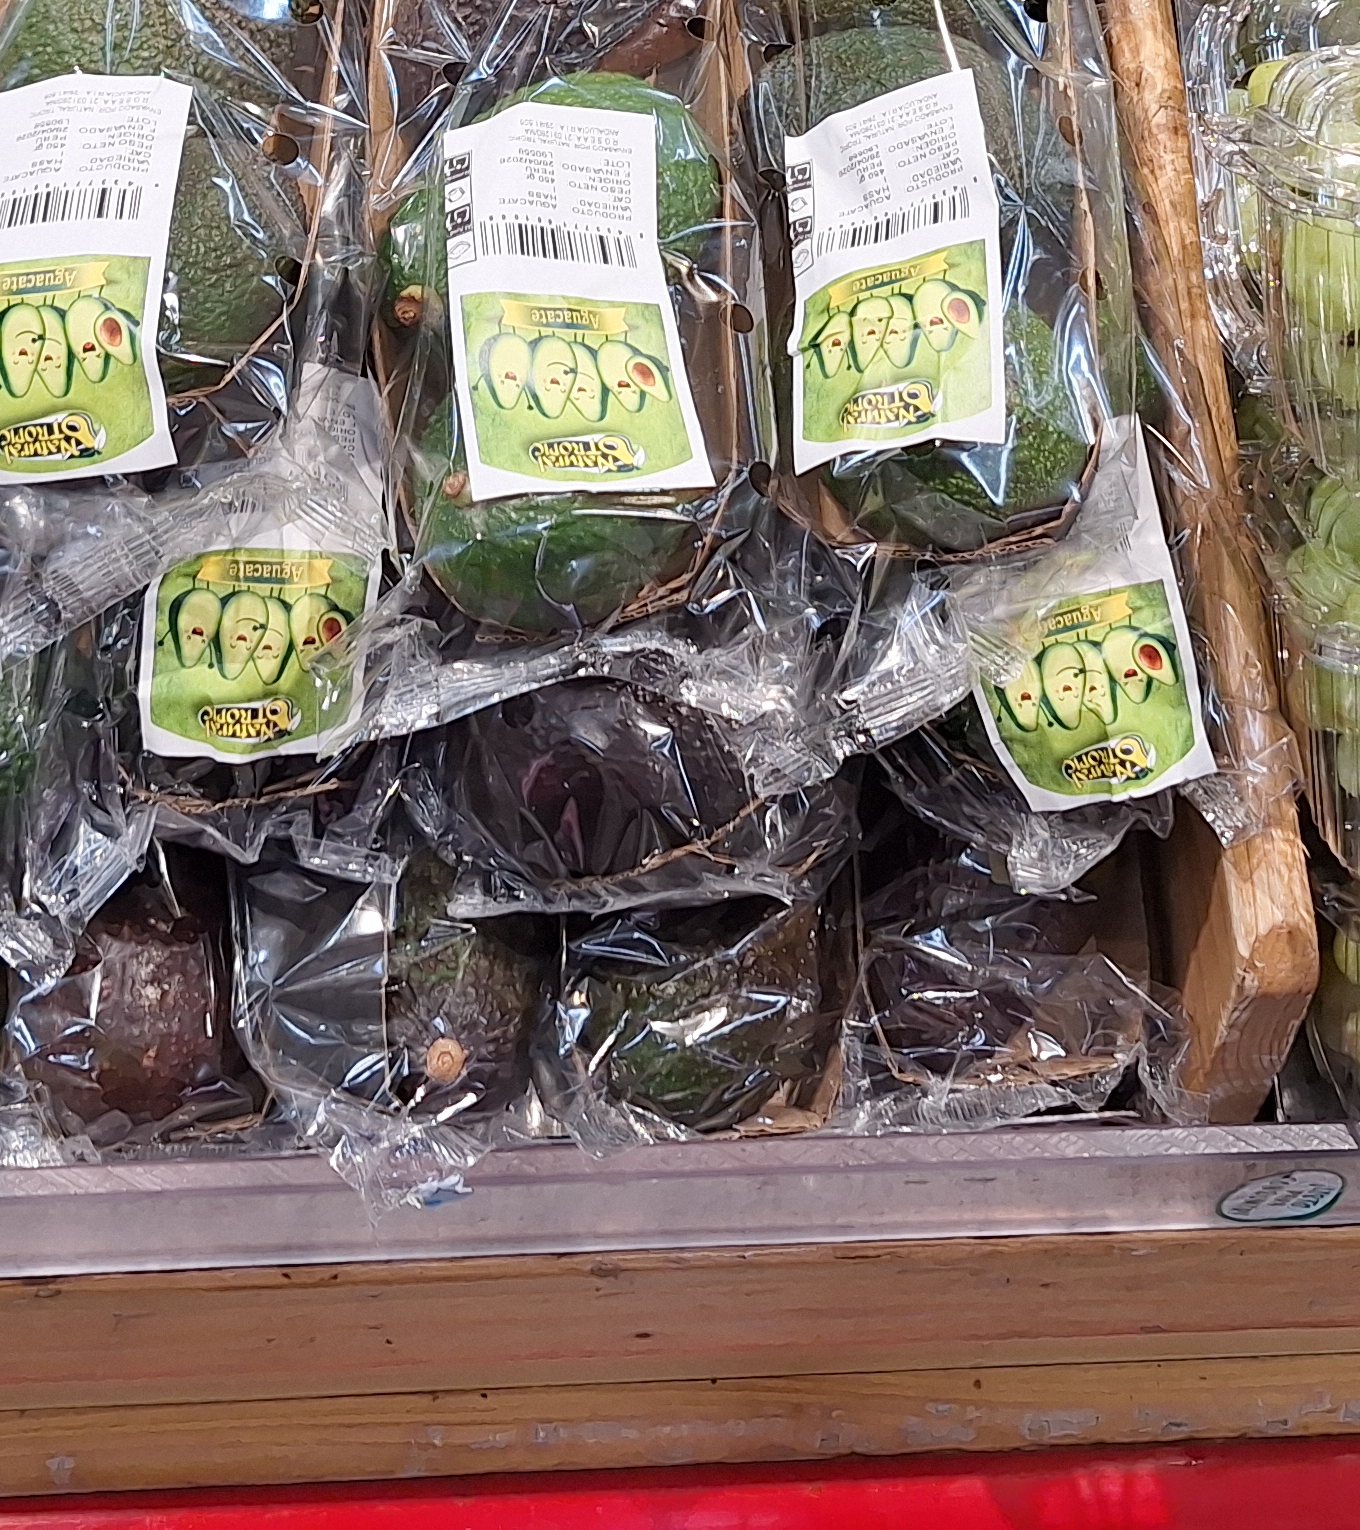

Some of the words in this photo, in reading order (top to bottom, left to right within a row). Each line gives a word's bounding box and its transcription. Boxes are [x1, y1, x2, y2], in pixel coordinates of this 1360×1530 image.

[2, 270, 78, 293] Aguacate
[852, 263, 921, 293] Aguacate
[530, 309, 599, 331] Aguacate
[841, 391, 908, 416] TROPIC
[841, 406, 917, 433] Natural
[0, 423, 68, 445] TROPIC
[4, 436, 83, 464] Natural
[531, 440, 601, 460] TROPIC
[539, 451, 617, 474] Natural
[229, 562, 303, 582] Aguacate
[204, 706, 269, 723] TROPIC
[206, 719, 274, 737] Natural
[1065, 747, 1116, 774] TROPIC
[1071, 760, 1134, 789] Natural
